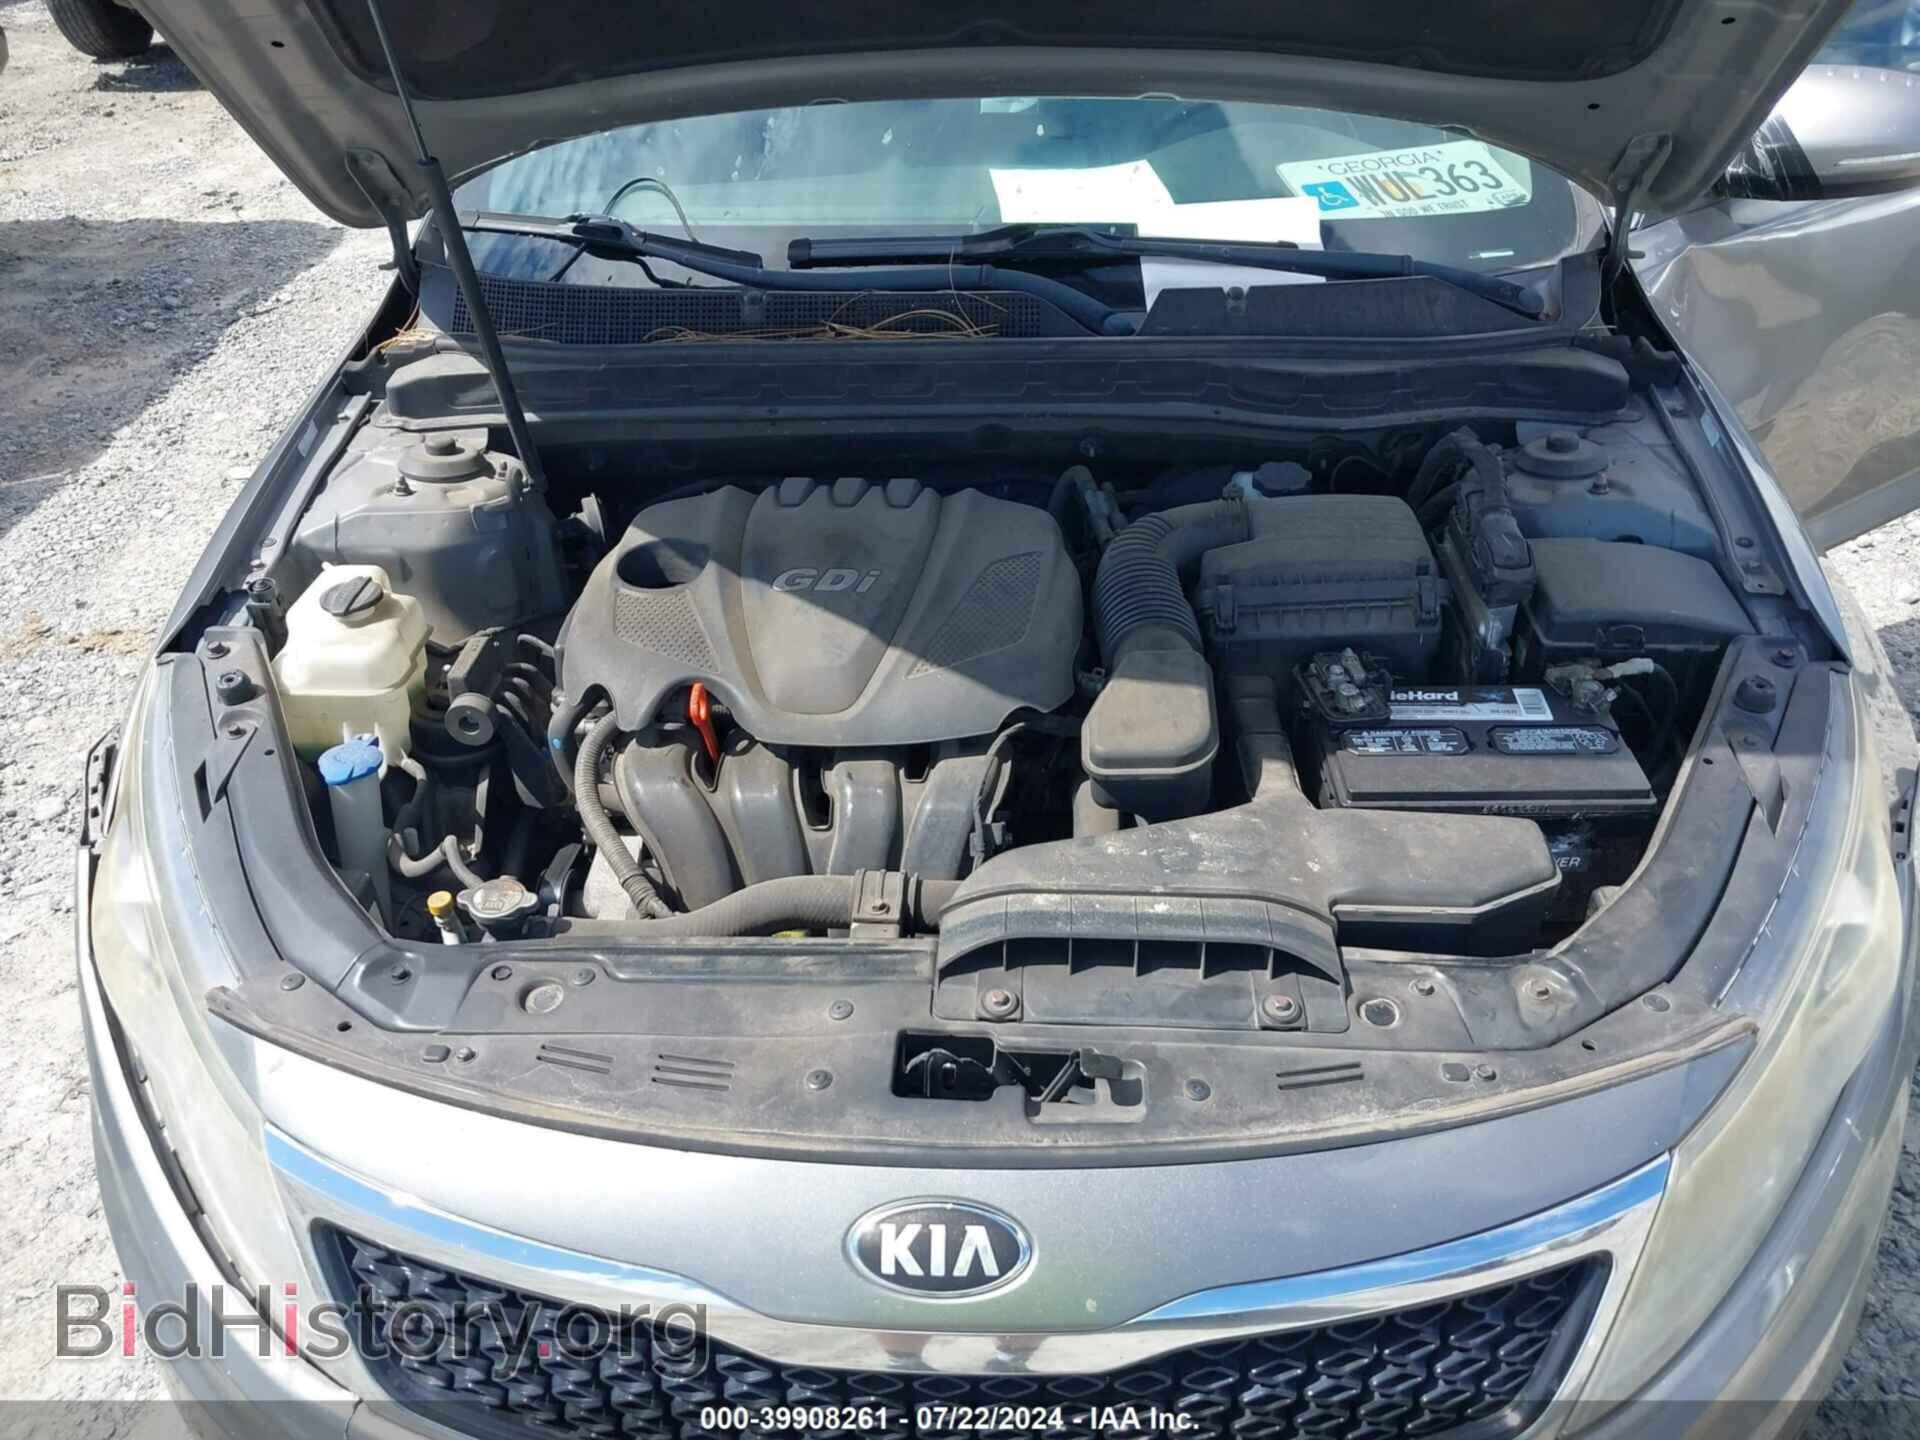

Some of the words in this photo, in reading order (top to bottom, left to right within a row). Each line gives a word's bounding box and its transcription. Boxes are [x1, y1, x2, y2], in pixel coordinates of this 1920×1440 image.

[1327, 151, 1440, 176] GEORGIA
[1345, 160, 1504, 207] WUL363
[772, 568, 881, 592] GDi
[1390, 690, 1459, 701] ieHard
[880, 1223, 1000, 1277] KIA
